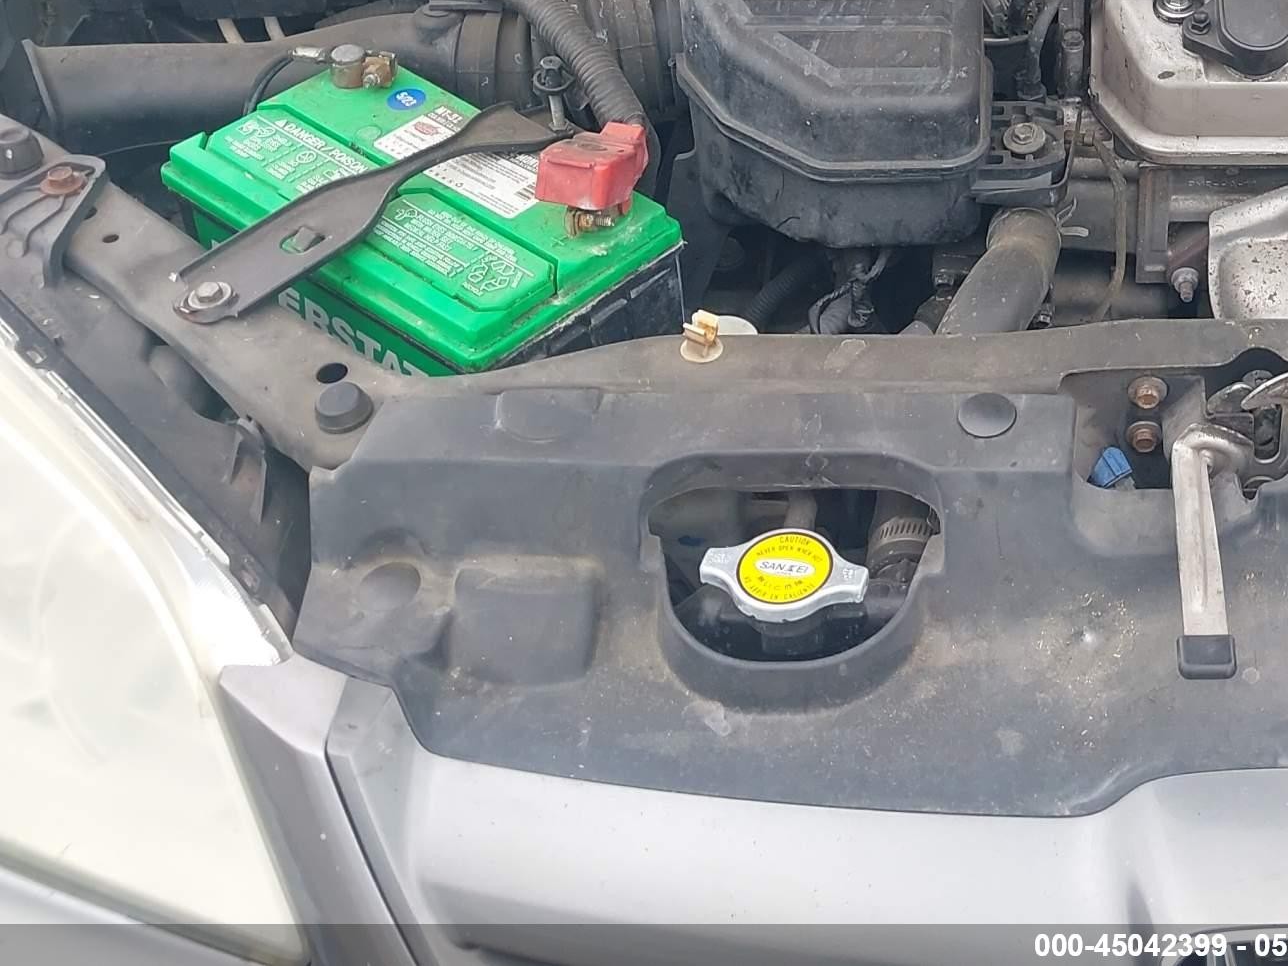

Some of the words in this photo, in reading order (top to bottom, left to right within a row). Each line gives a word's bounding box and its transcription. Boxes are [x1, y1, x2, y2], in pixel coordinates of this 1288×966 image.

[285, 123, 326, 151] DANGER
[330, 148, 368, 174] POISON
[779, 536, 812, 546] CAUTION
[756, 546, 776, 556] NEVER
[778, 544, 794, 552] OPEN
